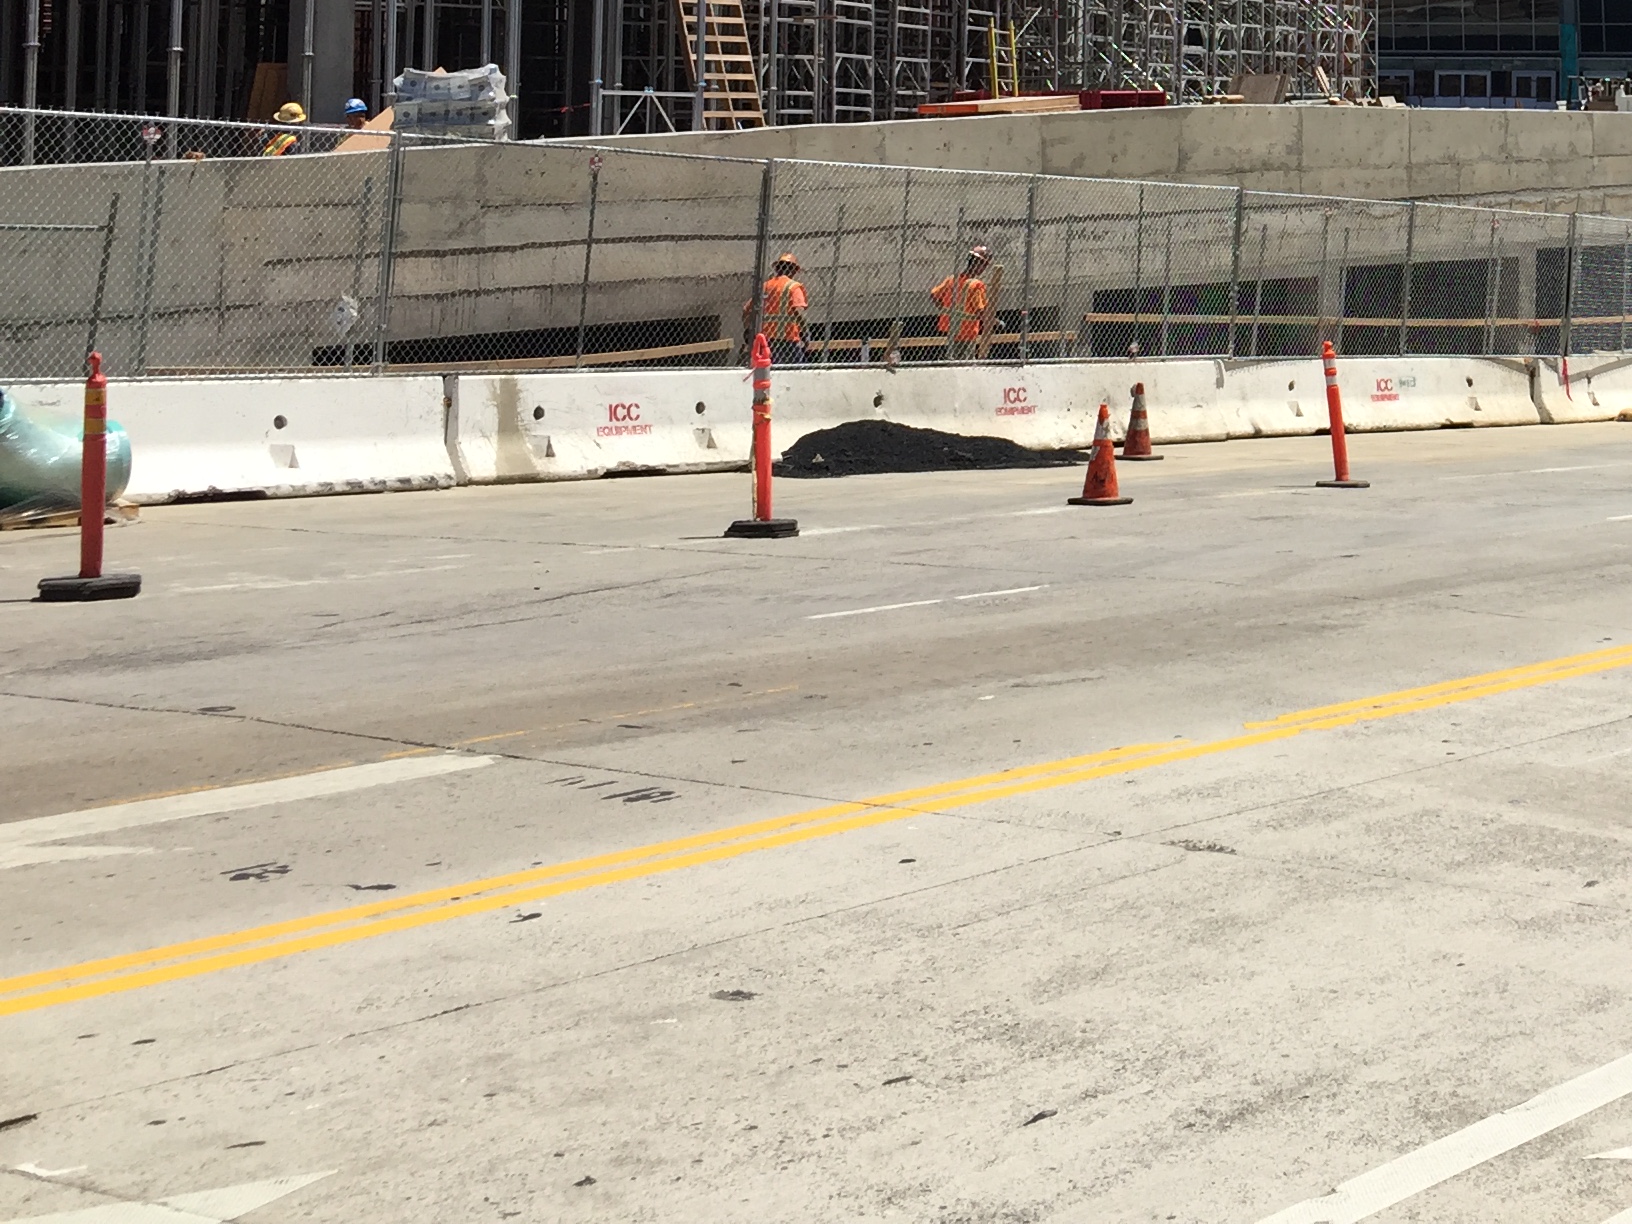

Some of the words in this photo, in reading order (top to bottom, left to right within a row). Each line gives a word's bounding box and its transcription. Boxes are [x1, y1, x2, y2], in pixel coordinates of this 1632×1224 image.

[1376, 378, 1393, 392] ICC
[1003, 387, 1027, 404] ICC
[608, 402, 641, 422] ICC
[596, 424, 653, 437] EQUIPMENT
